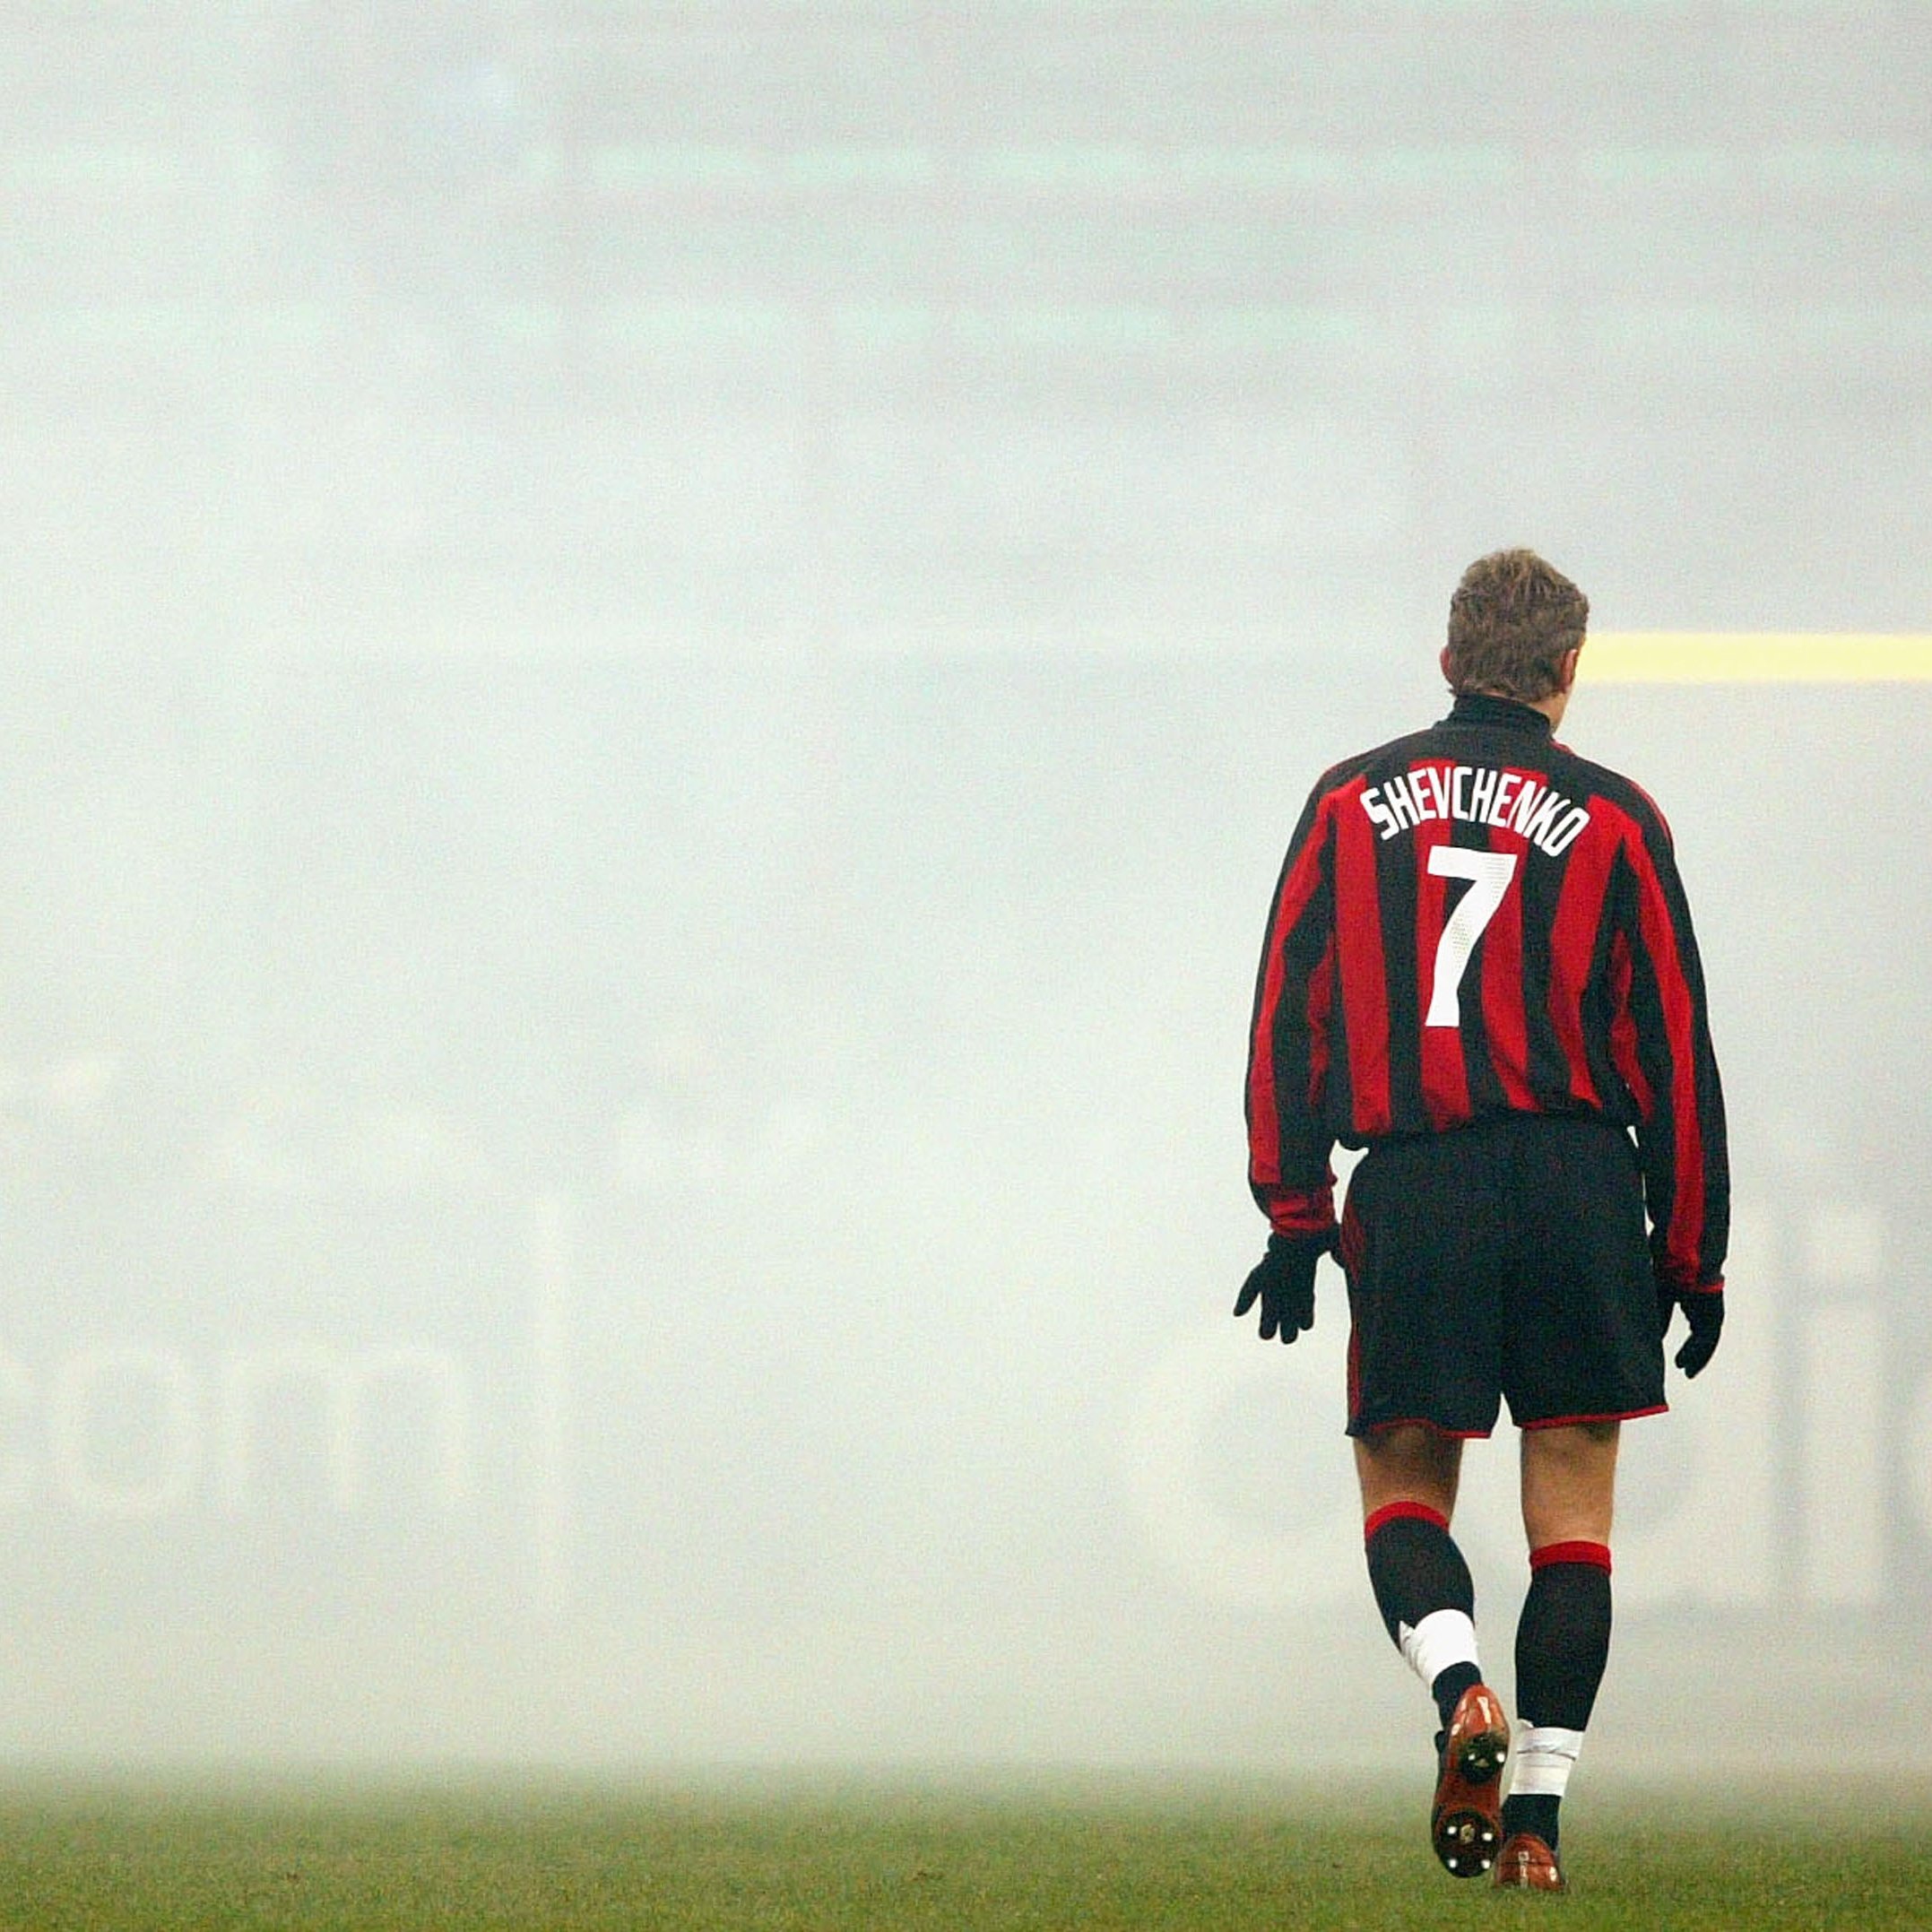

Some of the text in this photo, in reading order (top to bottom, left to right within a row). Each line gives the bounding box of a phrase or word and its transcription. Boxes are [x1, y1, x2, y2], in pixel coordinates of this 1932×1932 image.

[1359, 766, 1590, 857] SHEVCHENKO
[1425, 845, 1518, 1027] 7
[0, 1338, 472, 1518] om
